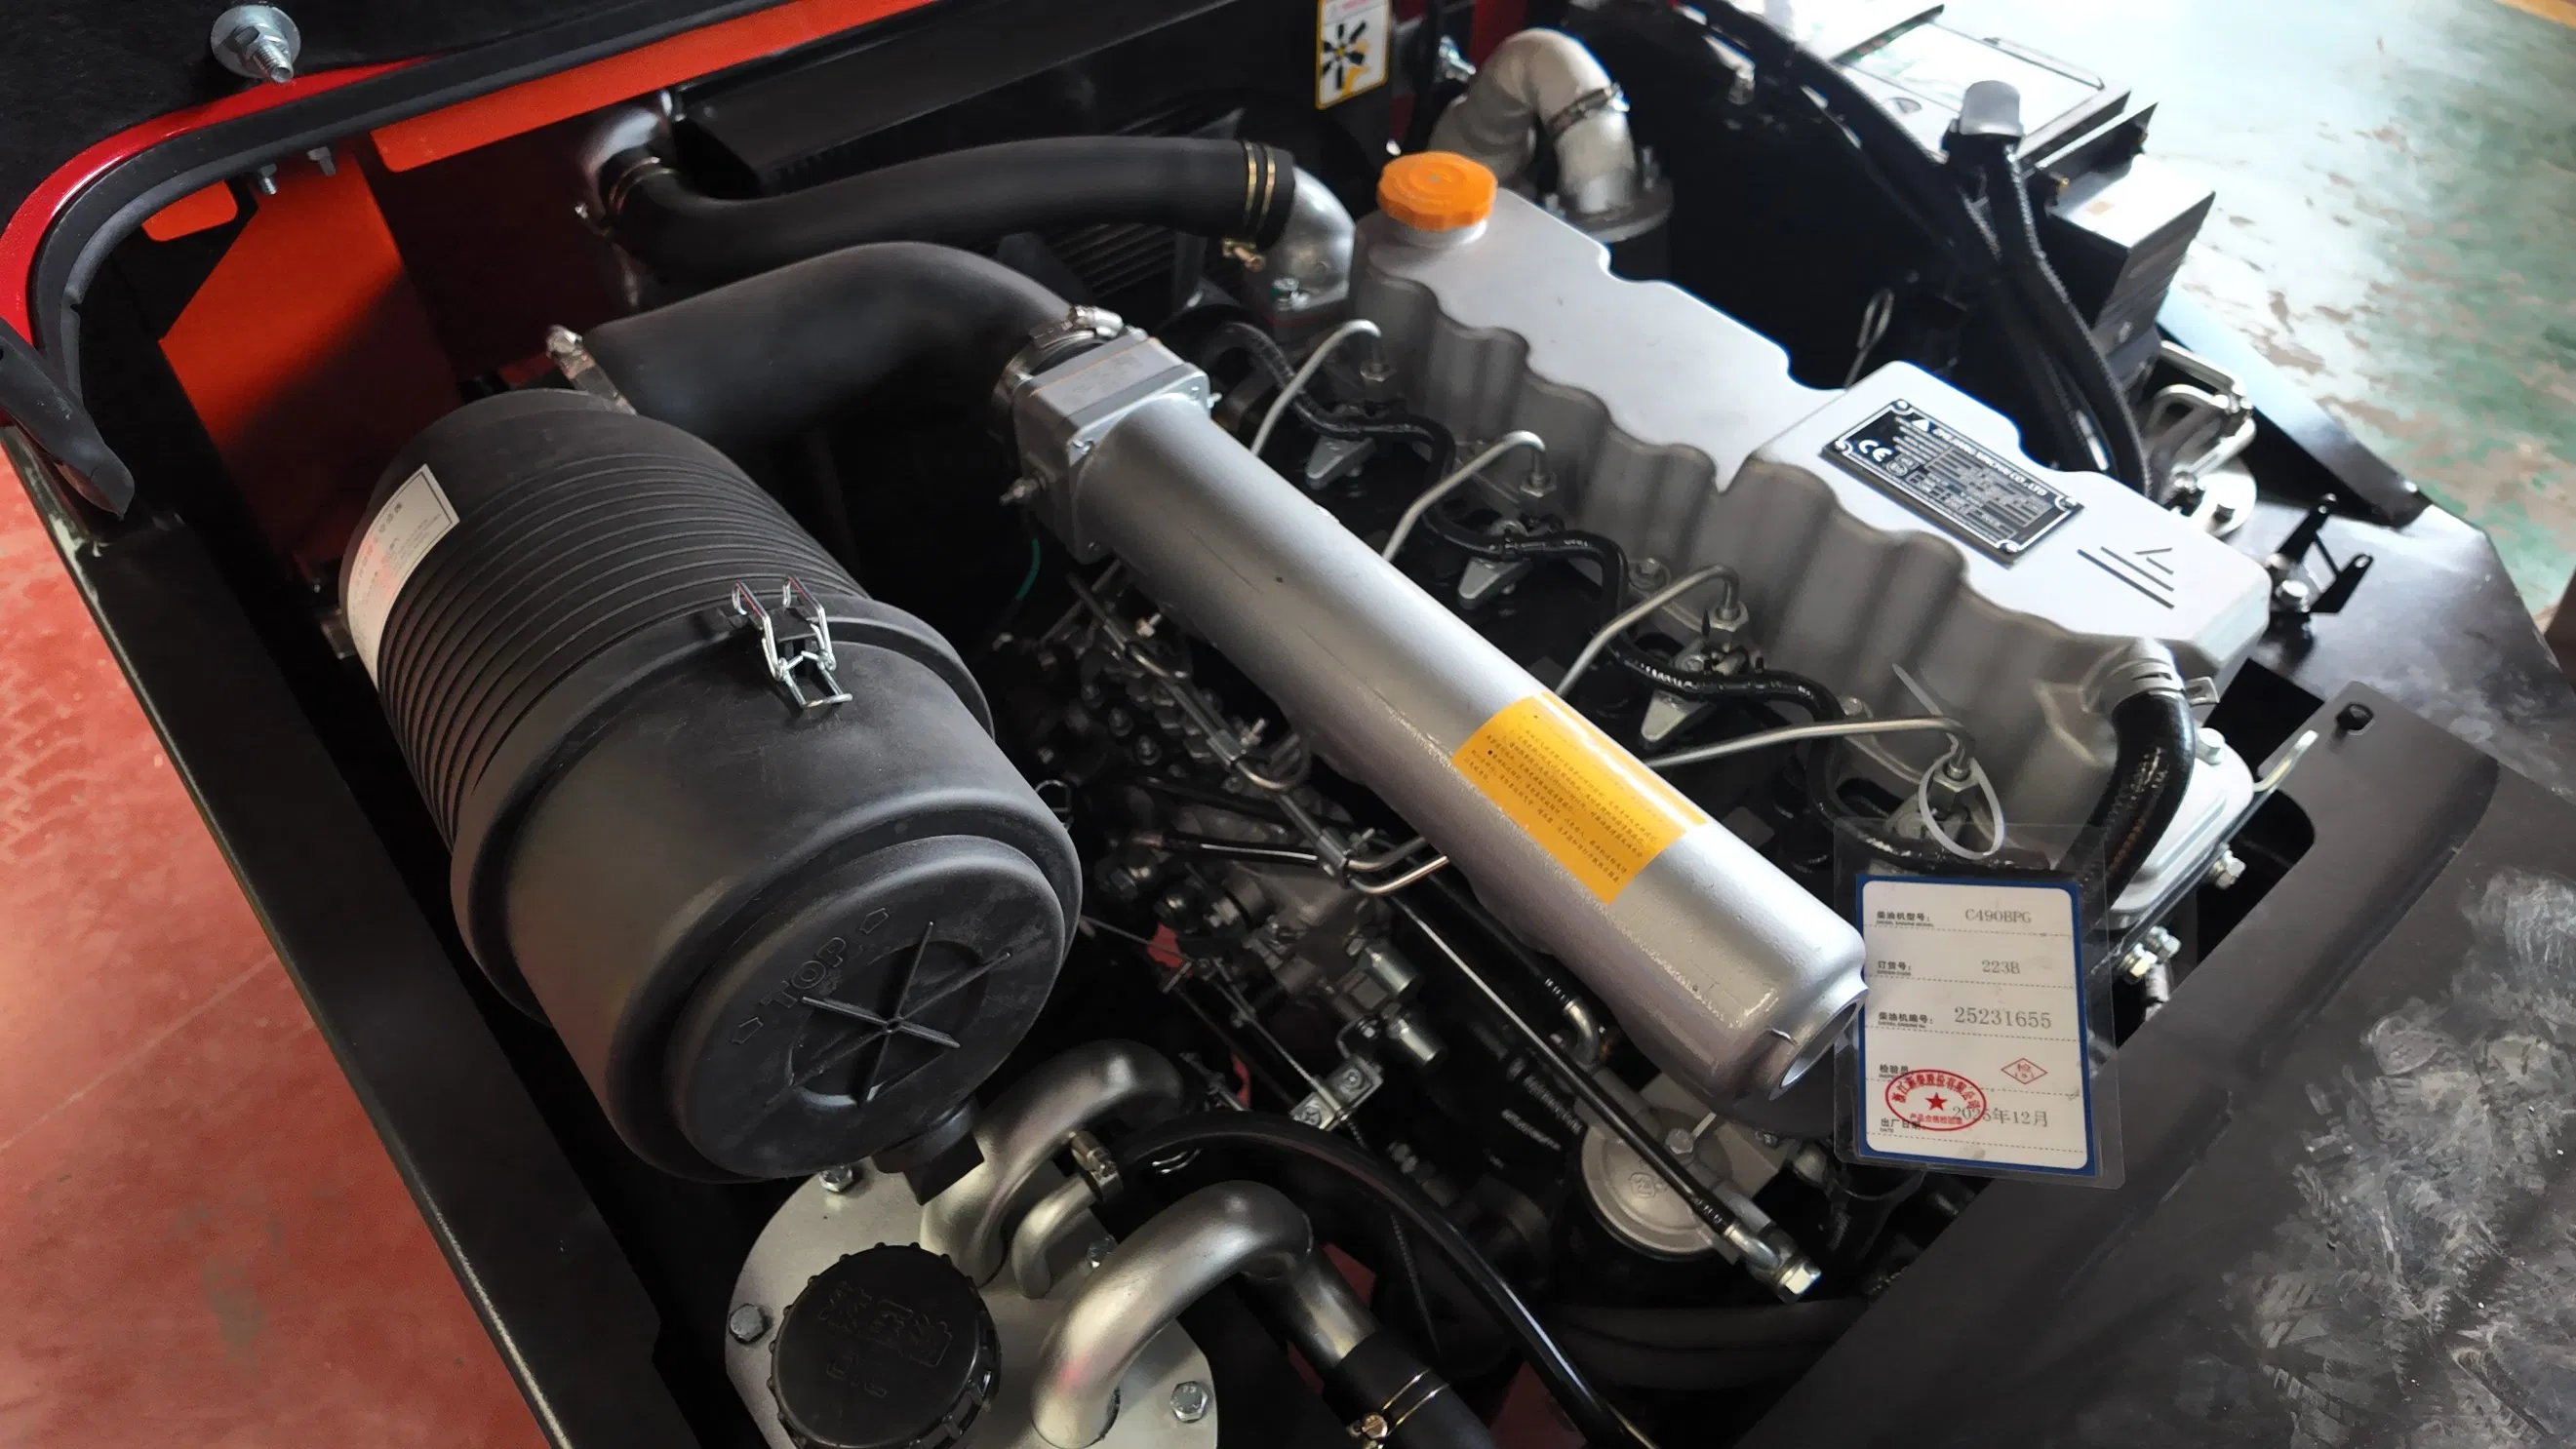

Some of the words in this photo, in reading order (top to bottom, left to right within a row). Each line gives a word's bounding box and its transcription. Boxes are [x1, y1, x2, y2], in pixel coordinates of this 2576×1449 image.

[1858, 439, 1892, 462] CE
[1963, 908, 2033, 924] C490BPG
[760, 935, 848, 1009] TOP
[1981, 959, 2021, 975] 223B
[1954, 1006, 2052, 1030] 25231655
